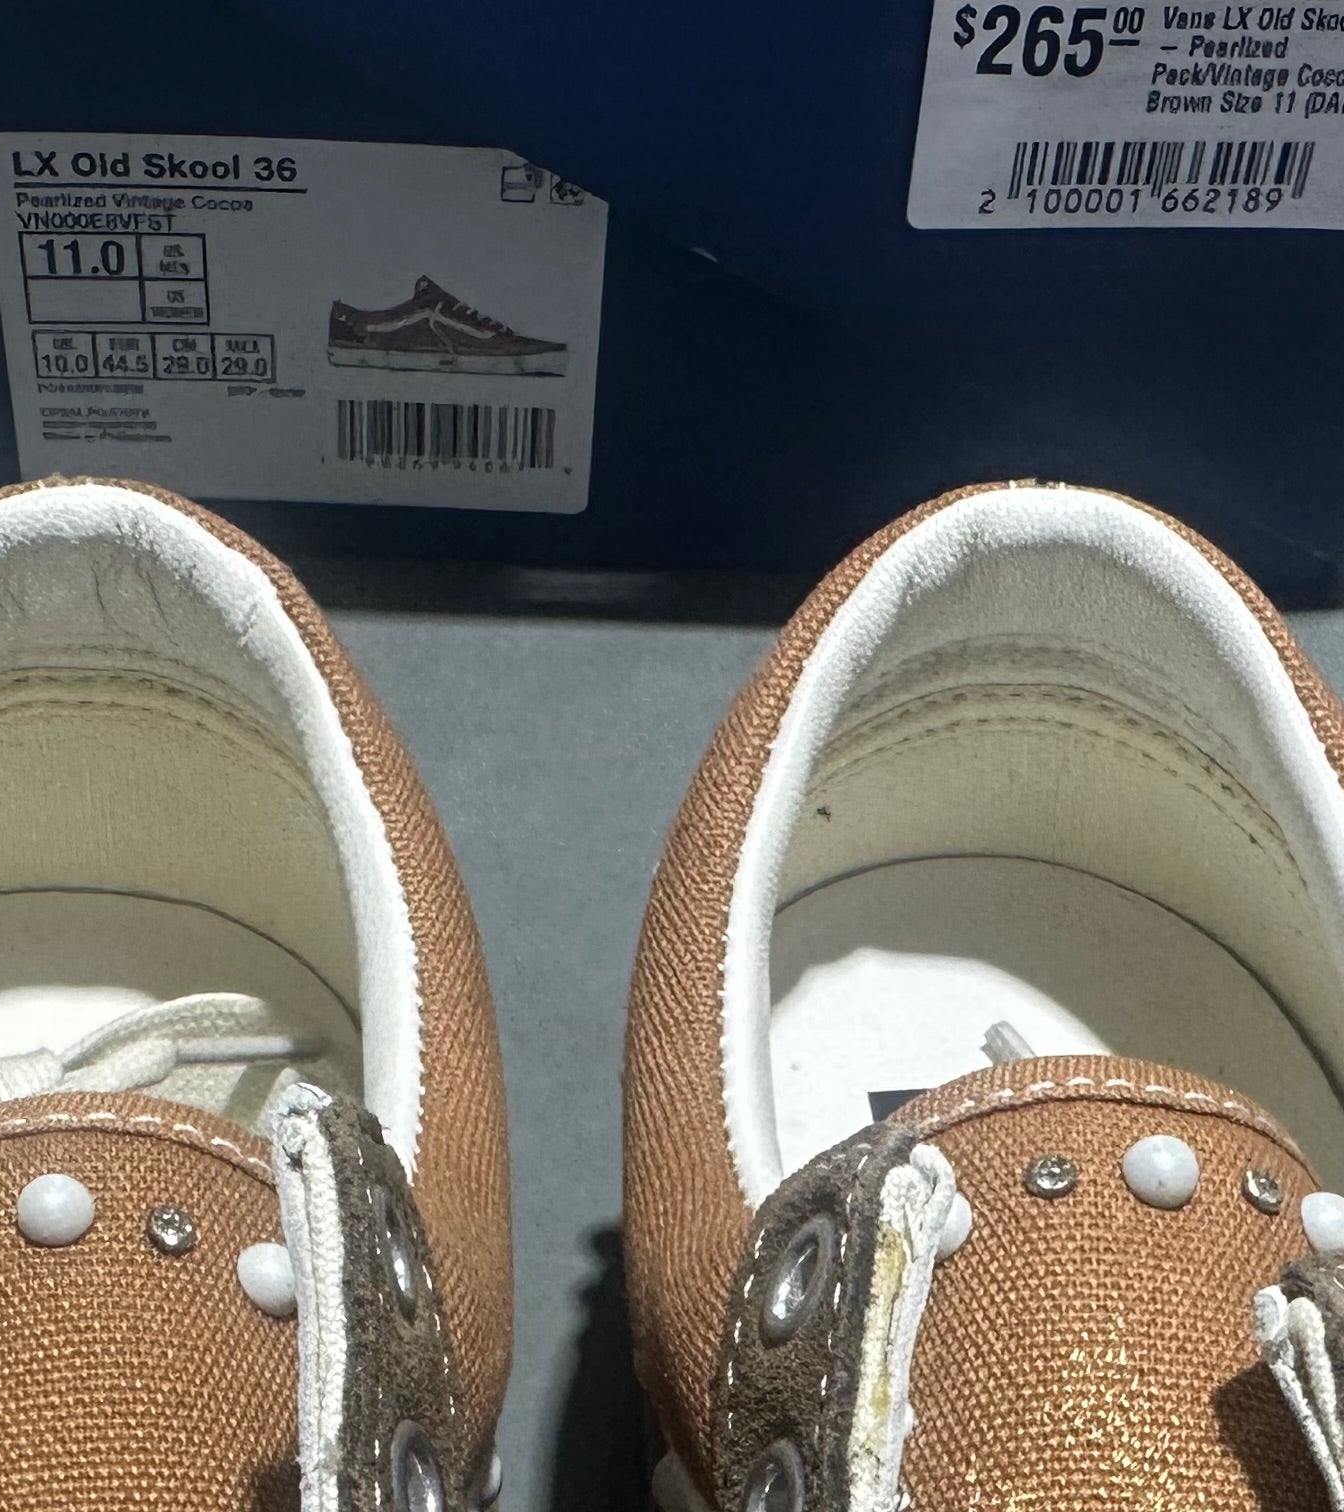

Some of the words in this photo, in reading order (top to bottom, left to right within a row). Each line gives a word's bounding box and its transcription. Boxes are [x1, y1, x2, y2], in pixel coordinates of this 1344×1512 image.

[1163, 6, 1214, 30] Vans
[1223, 6, 1253, 30] LX
[1258, 7, 1295, 31] Old
[1189, 35, 1289, 59] Pearlized
[1152, 62, 1289, 91] Pack/Vintage
[1146, 90, 1213, 114] Brown
[1220, 91, 1263, 114] Size
[1274, 91, 1297, 114] 11
[12, 151, 60, 177] LX
[71, 152, 130, 177] Old
[143, 153, 240, 180] Skool
[253, 157, 298, 182] 36
[16, 193, 107, 209] Pearlized
[192, 196, 253, 212] Cocoa
[978, 190, 996, 214] 2
[1027, 189, 1140, 214] 100001
[1160, 188, 1284, 214] 662189
[38, 239, 126, 276] 11.0
